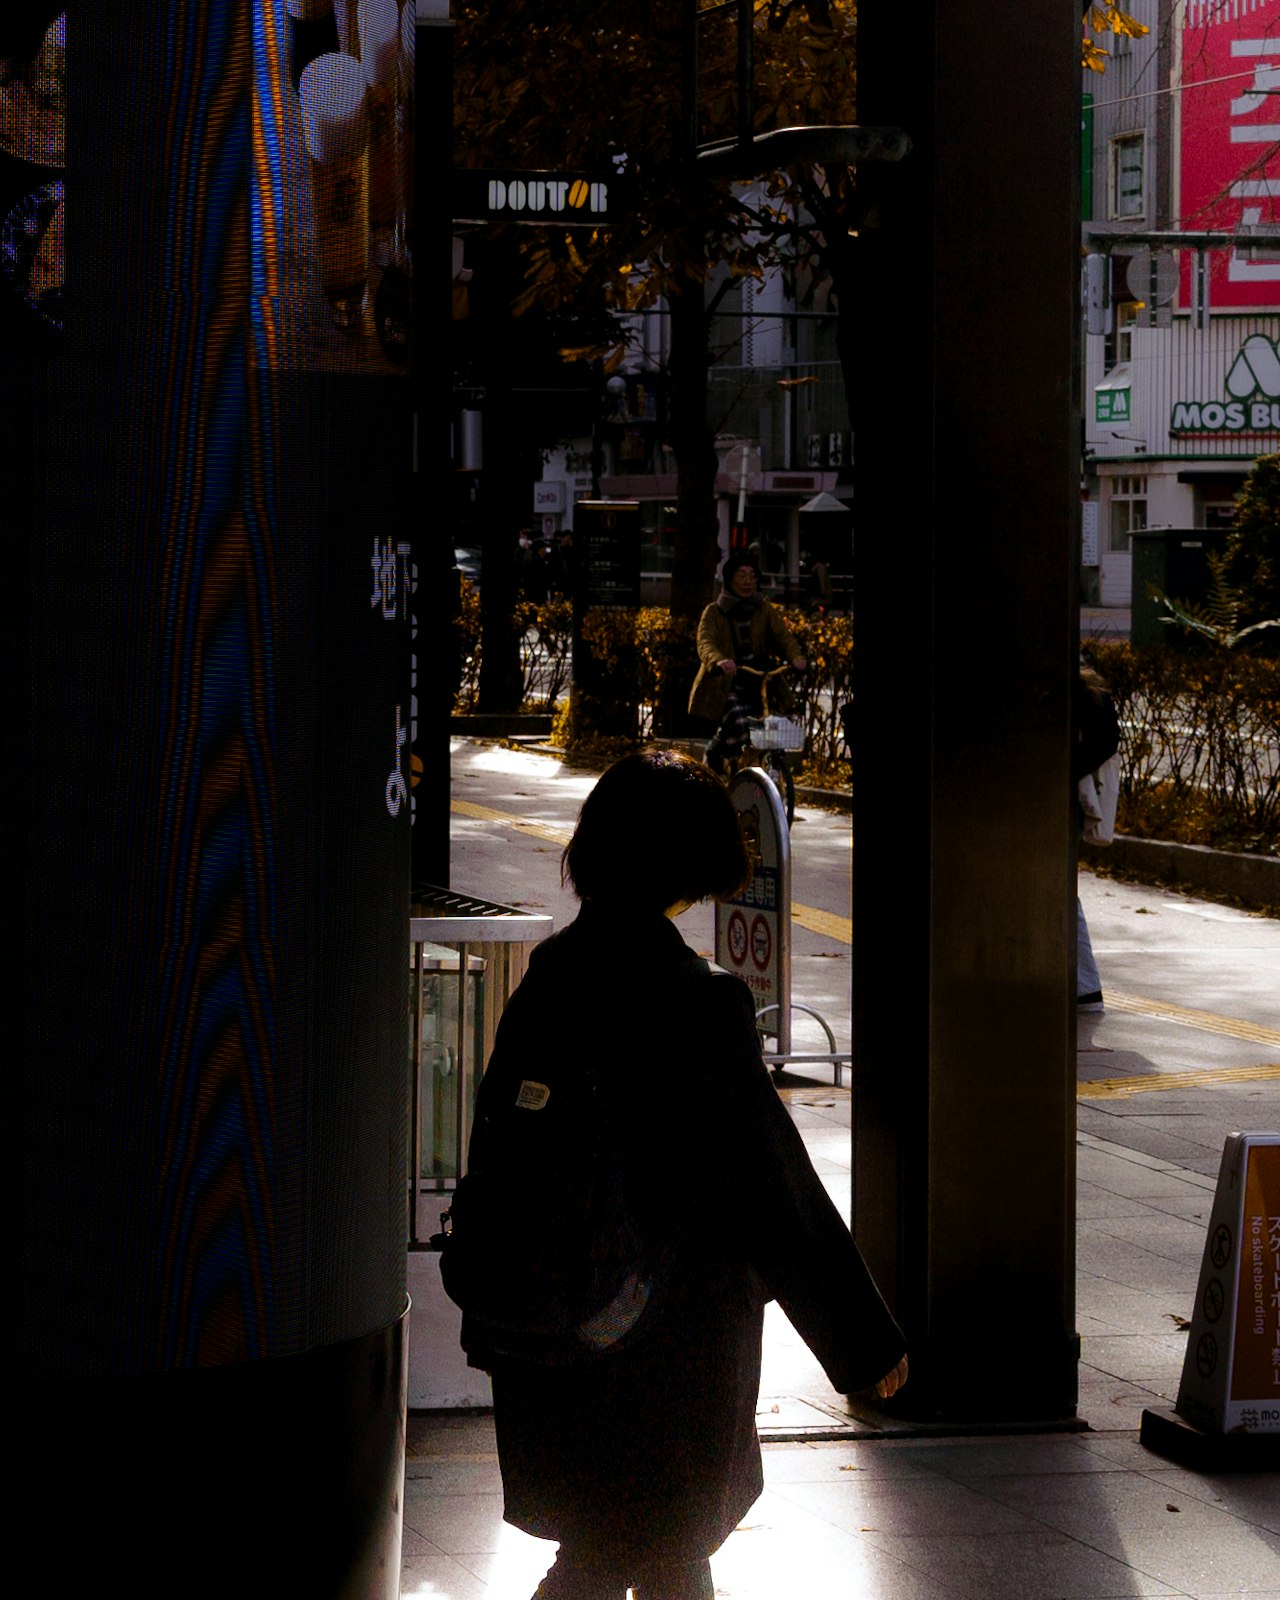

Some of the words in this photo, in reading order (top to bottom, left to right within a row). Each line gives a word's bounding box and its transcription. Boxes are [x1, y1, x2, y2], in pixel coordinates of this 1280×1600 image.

[488, 178, 608, 213] DOUTOR
[1173, 401, 1245, 430] MOS
[1251, 1215, 1263, 1234] No
[1252, 1237, 1268, 1336] skateboarding
